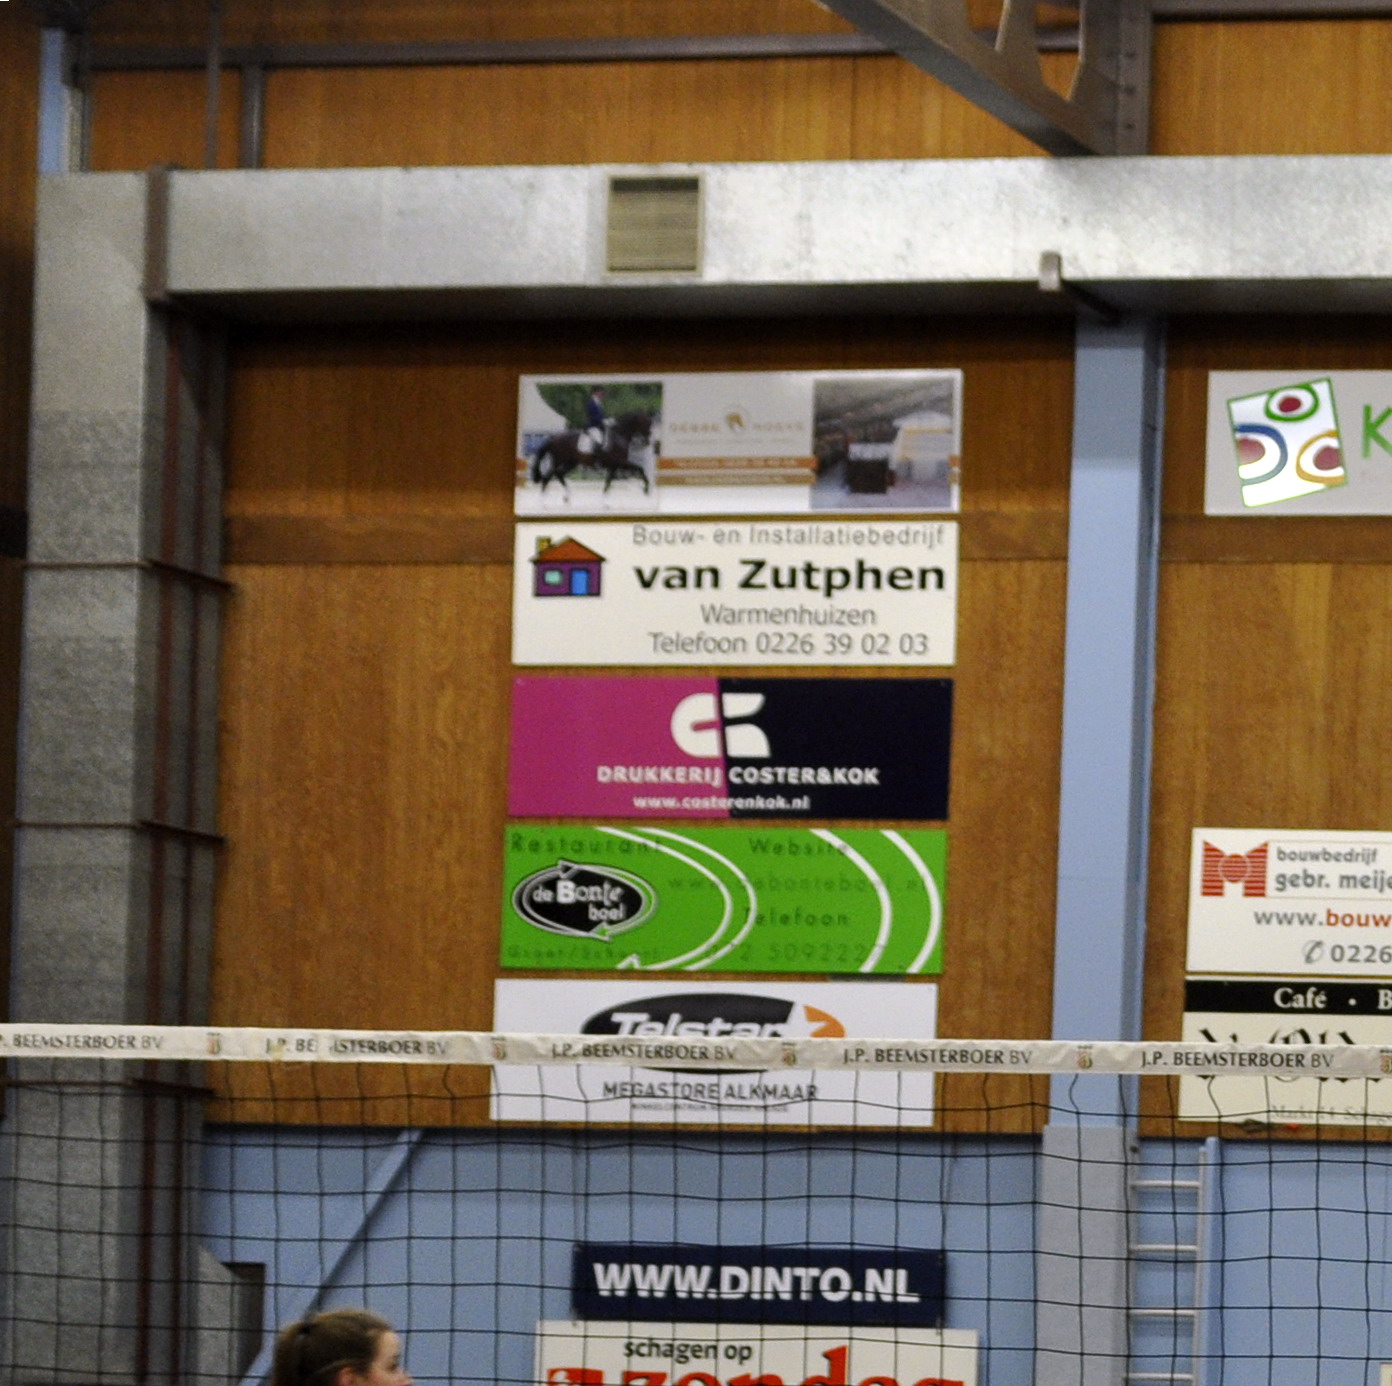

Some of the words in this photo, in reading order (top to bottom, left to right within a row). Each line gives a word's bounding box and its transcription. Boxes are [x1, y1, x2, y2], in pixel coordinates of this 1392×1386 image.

[749, 525, 945, 549] Installatiebedrijf
[633, 564, 721, 589] van
[739, 558, 945, 597] Zutphen
[701, 603, 875, 625] Warmenhuizen
[649, 631, 746, 654] Telefoon
[756, 632, 814, 654] 0226
[823, 633, 852, 654] 39
[862, 633, 890, 654] 02
[899, 633, 929, 654] 03
[596, 766, 722, 788] DRUKKERIJ
[729, 767, 879, 785] COSTER&KOK
[633, 795, 810, 810] www.costerenkok.nl
[1276, 847, 1378, 864] bouwbedrijf
[1275, 872, 1330, 891] gebr.
[1330, 945, 1392, 964] 0226
[1273, 986, 1327, 1009] Café
[874, 1048, 1004, 1066] BEEMSTERBOER
[1172, 1052, 1306, 1069] BEEMSTERBOER
[603, 1082, 719, 1099] MEGASTORE
[725, 1083, 818, 1100] ALKMAAR
[593, 1262, 920, 1303] WWW.DINTO.NL
[623, 1339, 717, 1364] schagen
[724, 1342, 752, 1361] op
